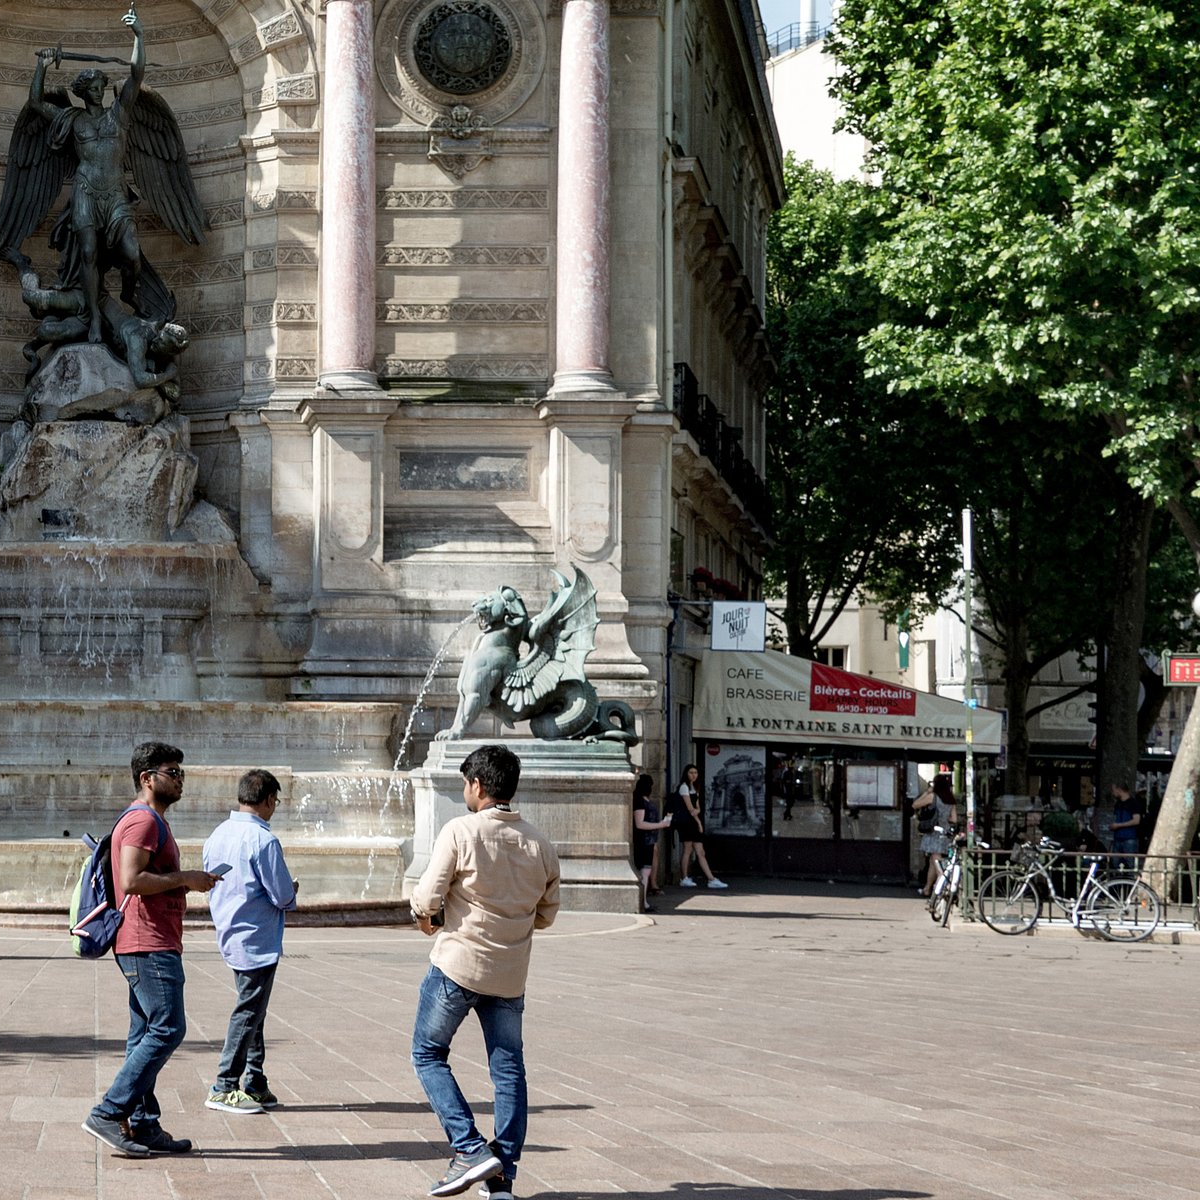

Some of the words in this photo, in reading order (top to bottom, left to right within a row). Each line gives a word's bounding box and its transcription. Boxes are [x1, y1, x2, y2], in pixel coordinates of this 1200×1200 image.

[721, 607, 744, 625] JOUR
[728, 615, 750, 634] NUIT
[726, 667, 764, 680] CAFE
[726, 687, 807, 702] BRASSERIE
[814, 685, 851, 696] Bières
[859, 687, 913, 700] Cocktails
[726, 716, 745, 728] LA
[752, 718, 837, 732] FONTAINE
[842, 722, 895, 736] SAINT
[900, 725, 965, 739] MICHEL
